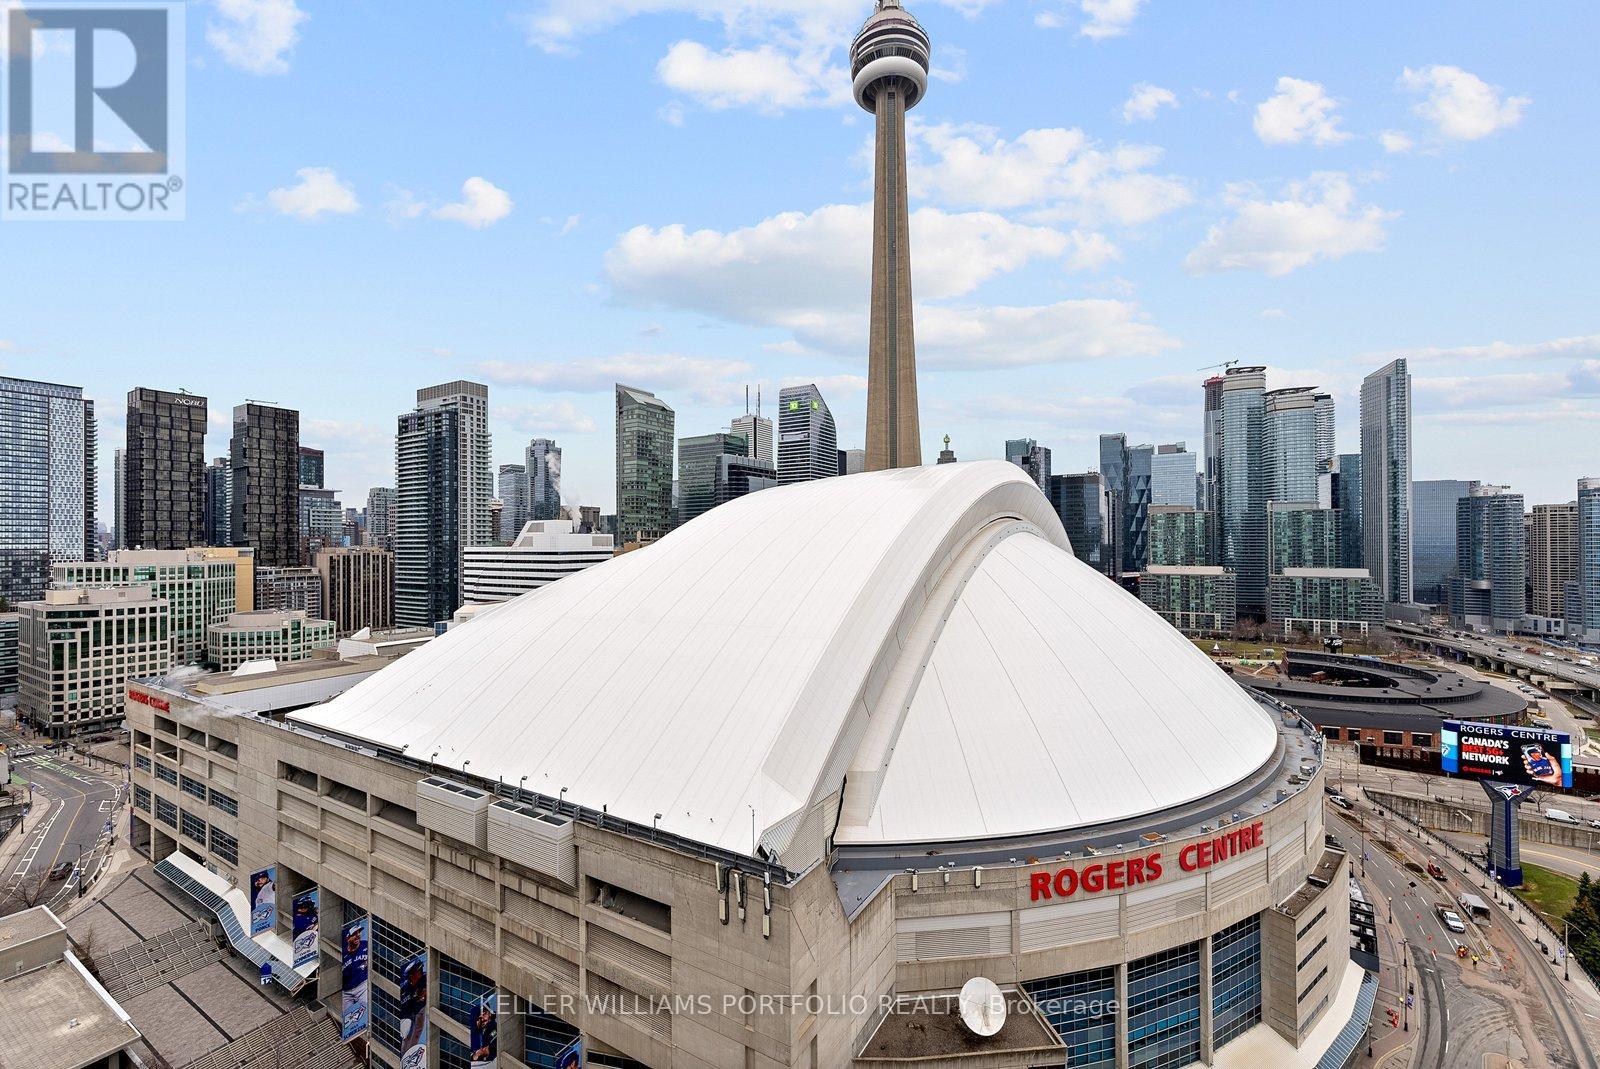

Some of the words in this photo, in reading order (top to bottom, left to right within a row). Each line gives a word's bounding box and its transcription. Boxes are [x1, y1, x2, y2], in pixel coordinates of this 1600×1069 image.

[1460, 725, 1504, 736] ROGERS
[1511, 730, 1558, 742] CENTRE
[1461, 736, 1510, 749] CANADA'S
[1462, 744, 1484, 753] BEST
[1461, 751, 1510, 765] NETWORK
[1030, 853, 1163, 901] ROGERS
[1178, 821, 1265, 872] CENTRE
